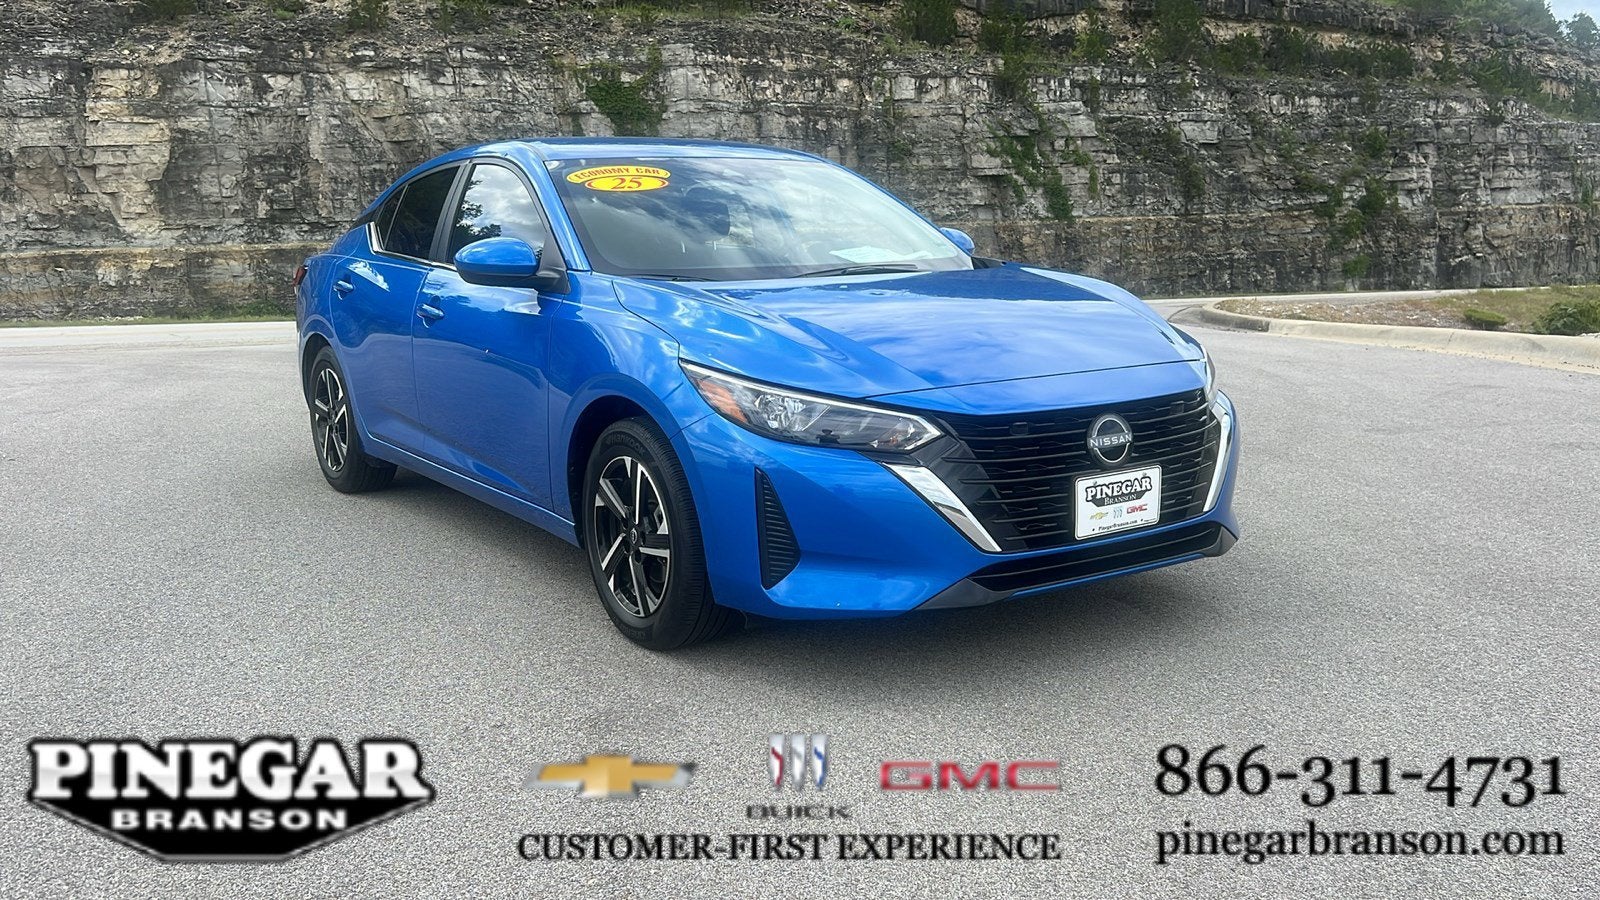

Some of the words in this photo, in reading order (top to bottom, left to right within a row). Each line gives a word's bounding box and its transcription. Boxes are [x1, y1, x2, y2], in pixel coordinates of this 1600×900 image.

[574, 167, 631, 180] ECONOMY
[635, 167, 661, 175] CAR
[611, 177, 642, 190] 25
[1090, 434, 1133, 448] NISSAN
[1085, 476, 1152, 502] PINEGAR
[1126, 504, 1148, 515] GMC
